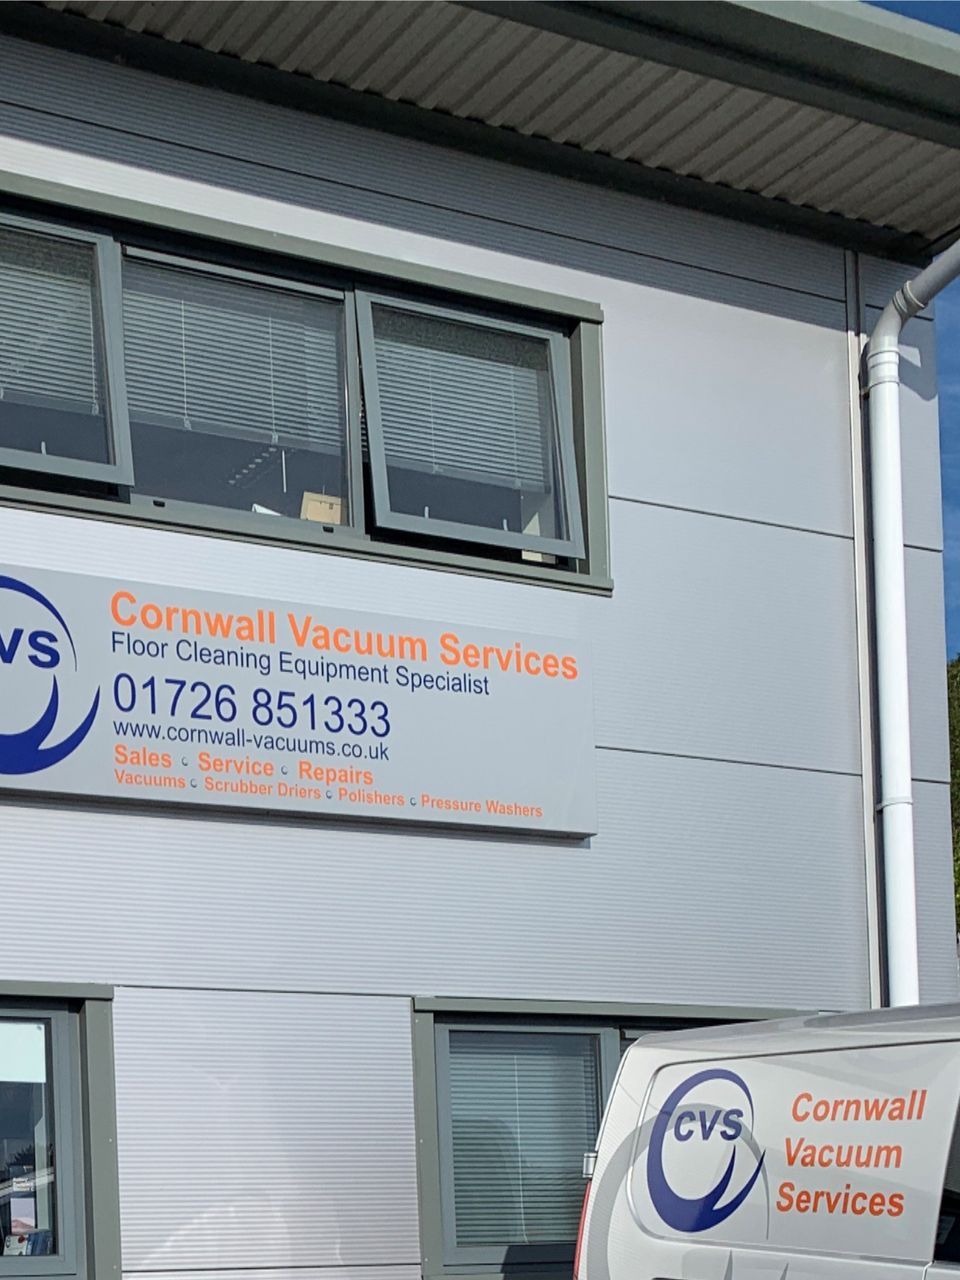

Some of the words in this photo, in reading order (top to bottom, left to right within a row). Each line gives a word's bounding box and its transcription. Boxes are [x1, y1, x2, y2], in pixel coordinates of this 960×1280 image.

[110, 590, 276, 645] Cornwall
[287, 613, 428, 662] Vacuum
[440, 632, 579, 680] Services
[111, 631, 168, 659] Floor
[176, 640, 272, 675] Cleaning
[279, 651, 389, 684] Equipment
[396, 666, 490, 695] Specialist
[113, 673, 238, 722] 01726
[252, 688, 391, 738] 851333
[113, 721, 390, 760] www.cornwall-vacuums.co.uk
[114, 744, 172, 768] Sales
[198, 752, 274, 776] Service
[299, 760, 374, 786] Repairs
[114, 769, 186, 788] Vacuums
[204, 776, 273, 795] Scrubber
[278, 782, 321, 799] Driers
[339, 788, 405, 806] Polishers
[421, 795, 481, 812] Pressure
[486, 800, 543, 817] Washers
[674, 1108, 744, 1141] CVS
[792, 1089, 927, 1122] Cornwall
[784, 1137, 903, 1169] Vacuum
[776, 1182, 905, 1217] Services
